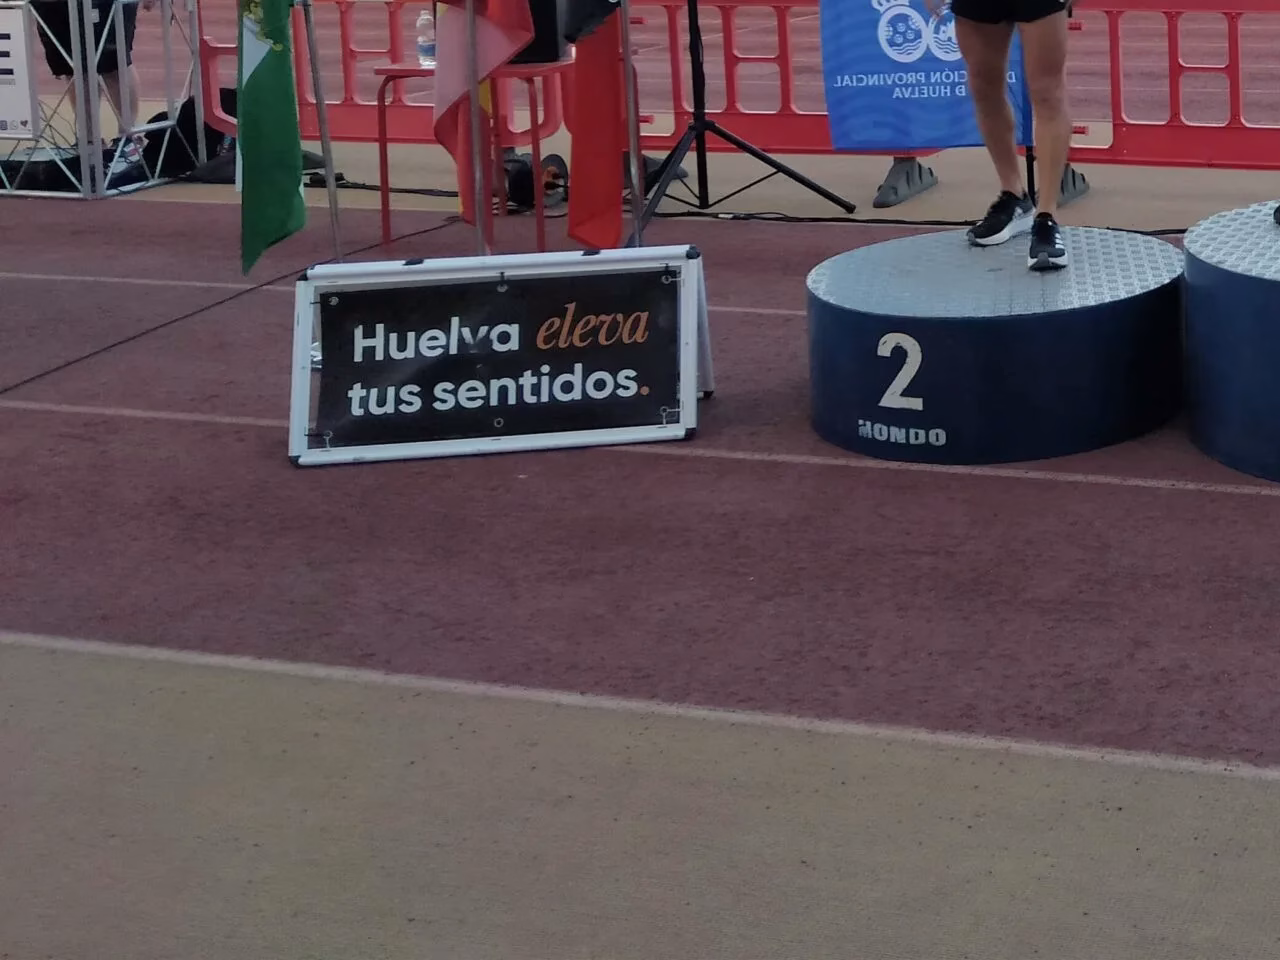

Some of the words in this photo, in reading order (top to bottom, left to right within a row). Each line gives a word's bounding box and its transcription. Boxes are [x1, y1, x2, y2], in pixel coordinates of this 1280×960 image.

[352, 316, 520, 363] Huelva
[535, 302, 650, 351] eleva
[347, 381, 423, 416] tus
[432, 362, 650, 411] sentidos.
[876, 332, 924, 411] 2
[858, 419, 947, 446] MONDO
